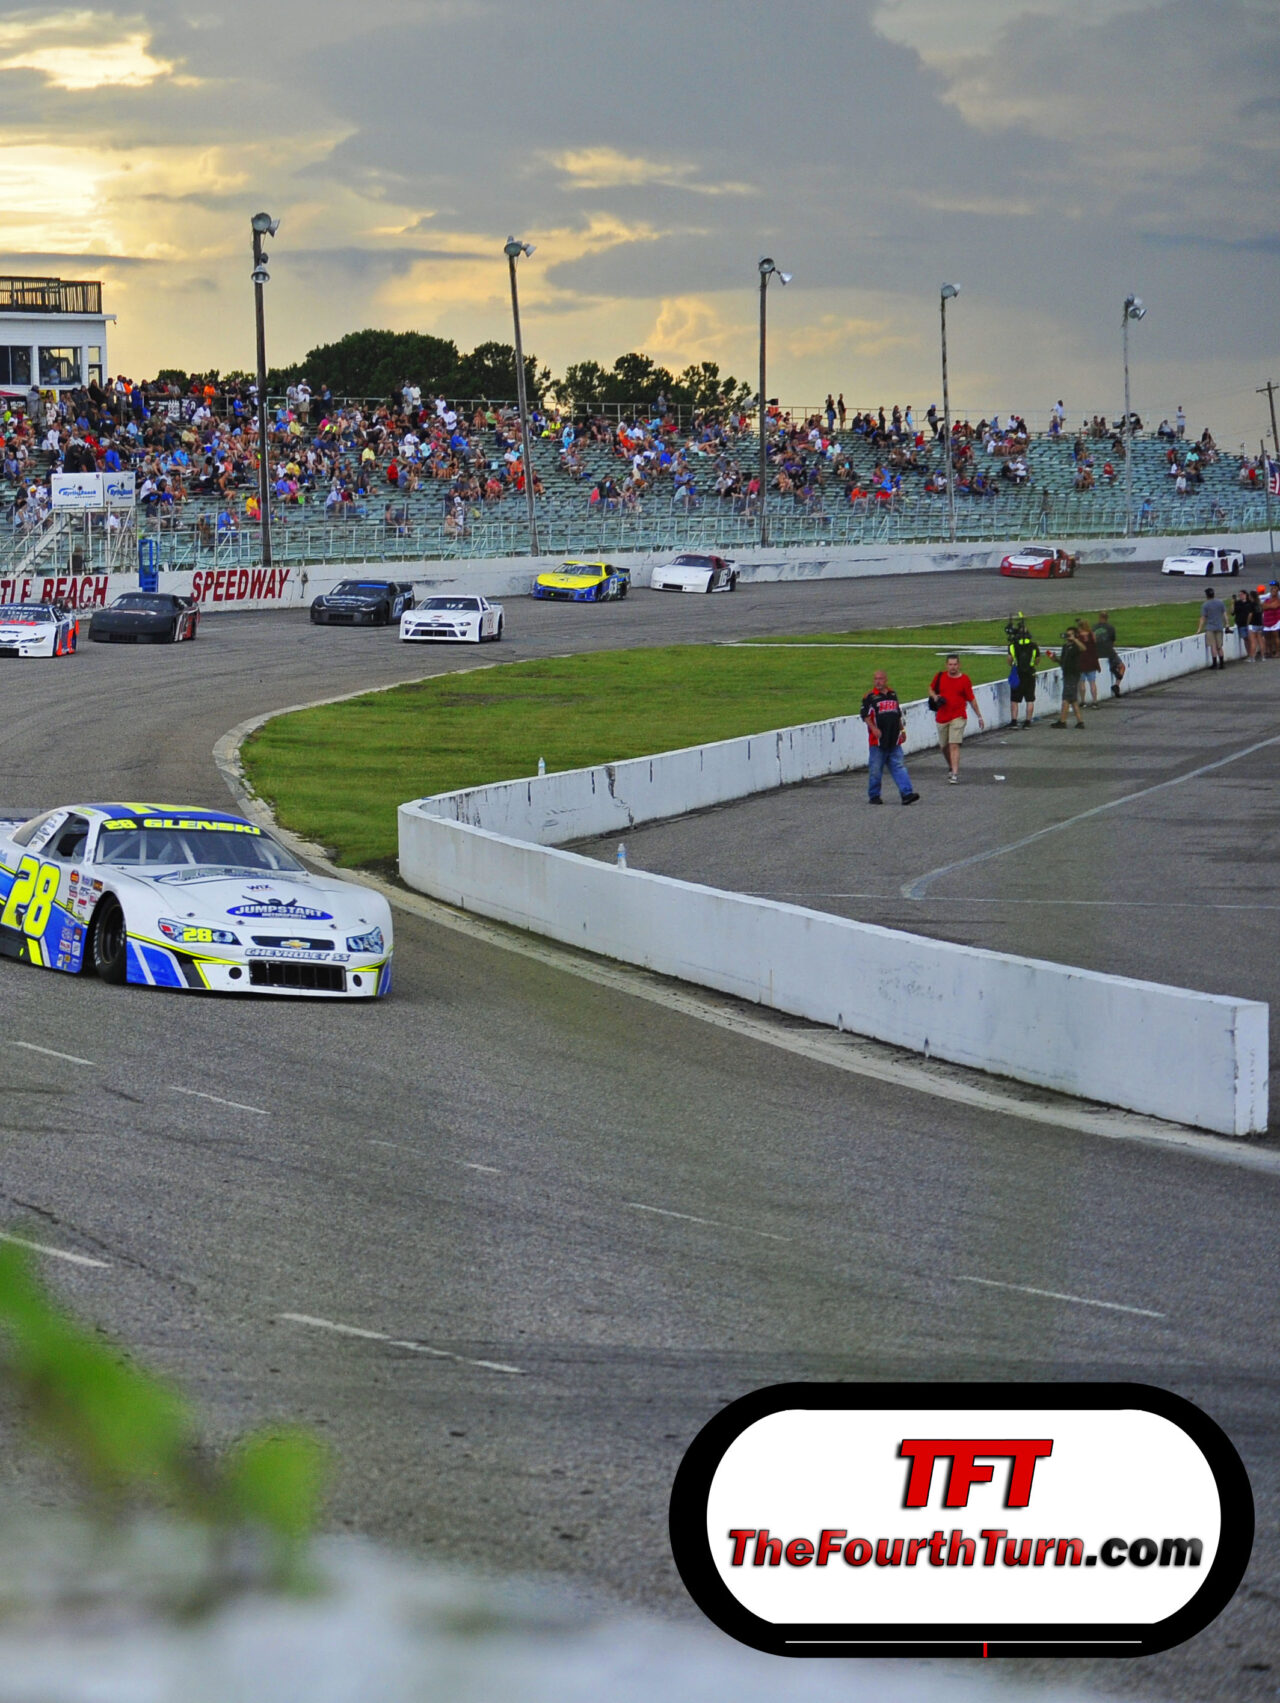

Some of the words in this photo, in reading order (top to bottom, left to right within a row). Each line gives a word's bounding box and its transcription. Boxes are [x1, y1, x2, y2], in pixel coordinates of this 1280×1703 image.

[41, 576, 109, 609] BEACH
[190, 569, 290, 602] SPEEDWAY
[103, 819, 138, 830] 28
[143, 819, 261, 835] GLENSKI
[1, 853, 61, 938] 28
[234, 905, 322, 917] JUMPSTART
[183, 927, 213, 942] 28
[245, 948, 330, 961] CHEVROLET
[331, 953, 351, 962] SS
